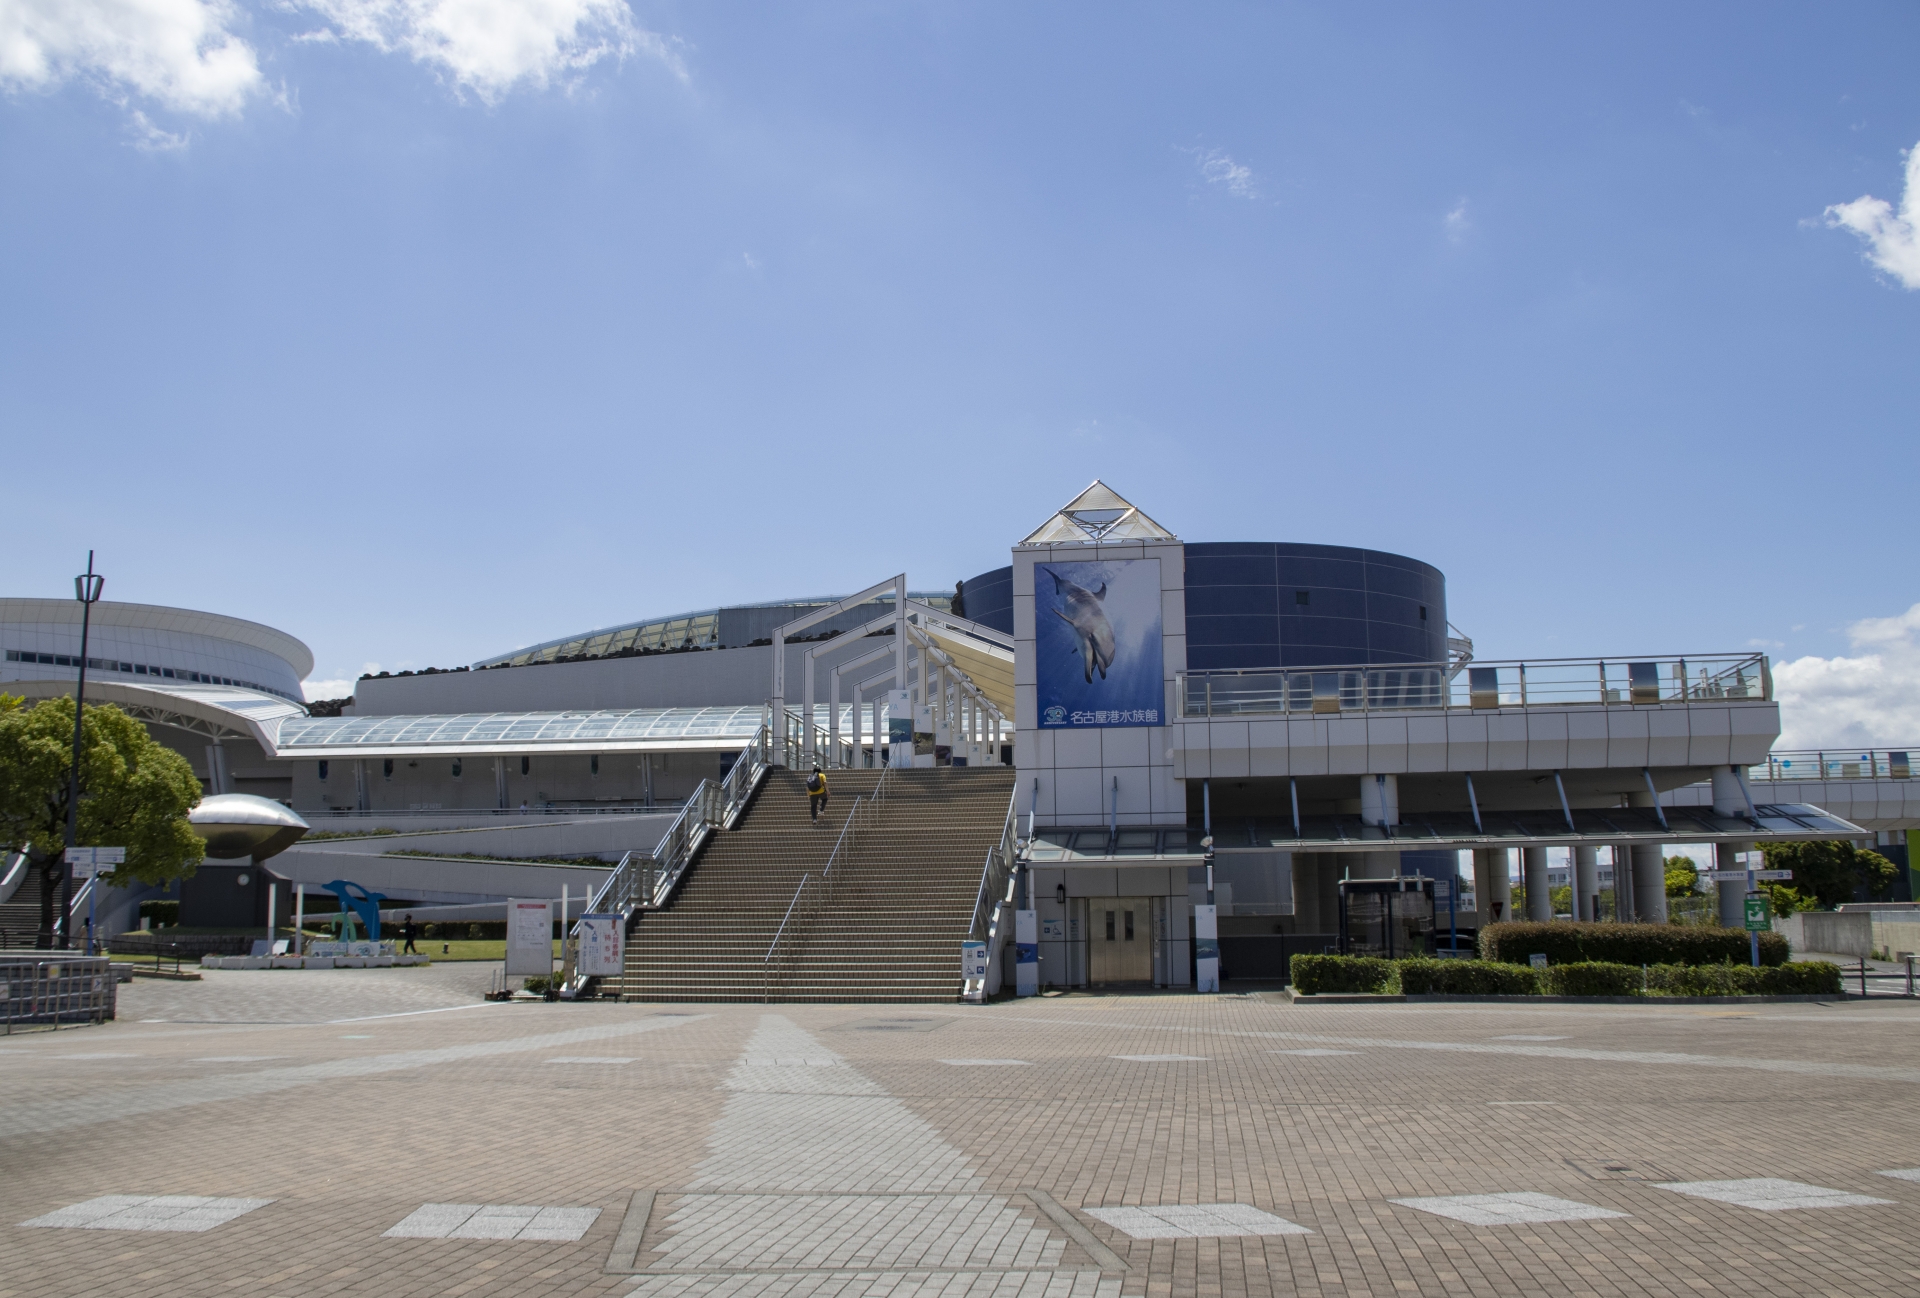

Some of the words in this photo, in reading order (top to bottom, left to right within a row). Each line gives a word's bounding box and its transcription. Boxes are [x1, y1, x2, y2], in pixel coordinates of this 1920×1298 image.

[1070, 708, 1158, 725] 名古屋港水族館
